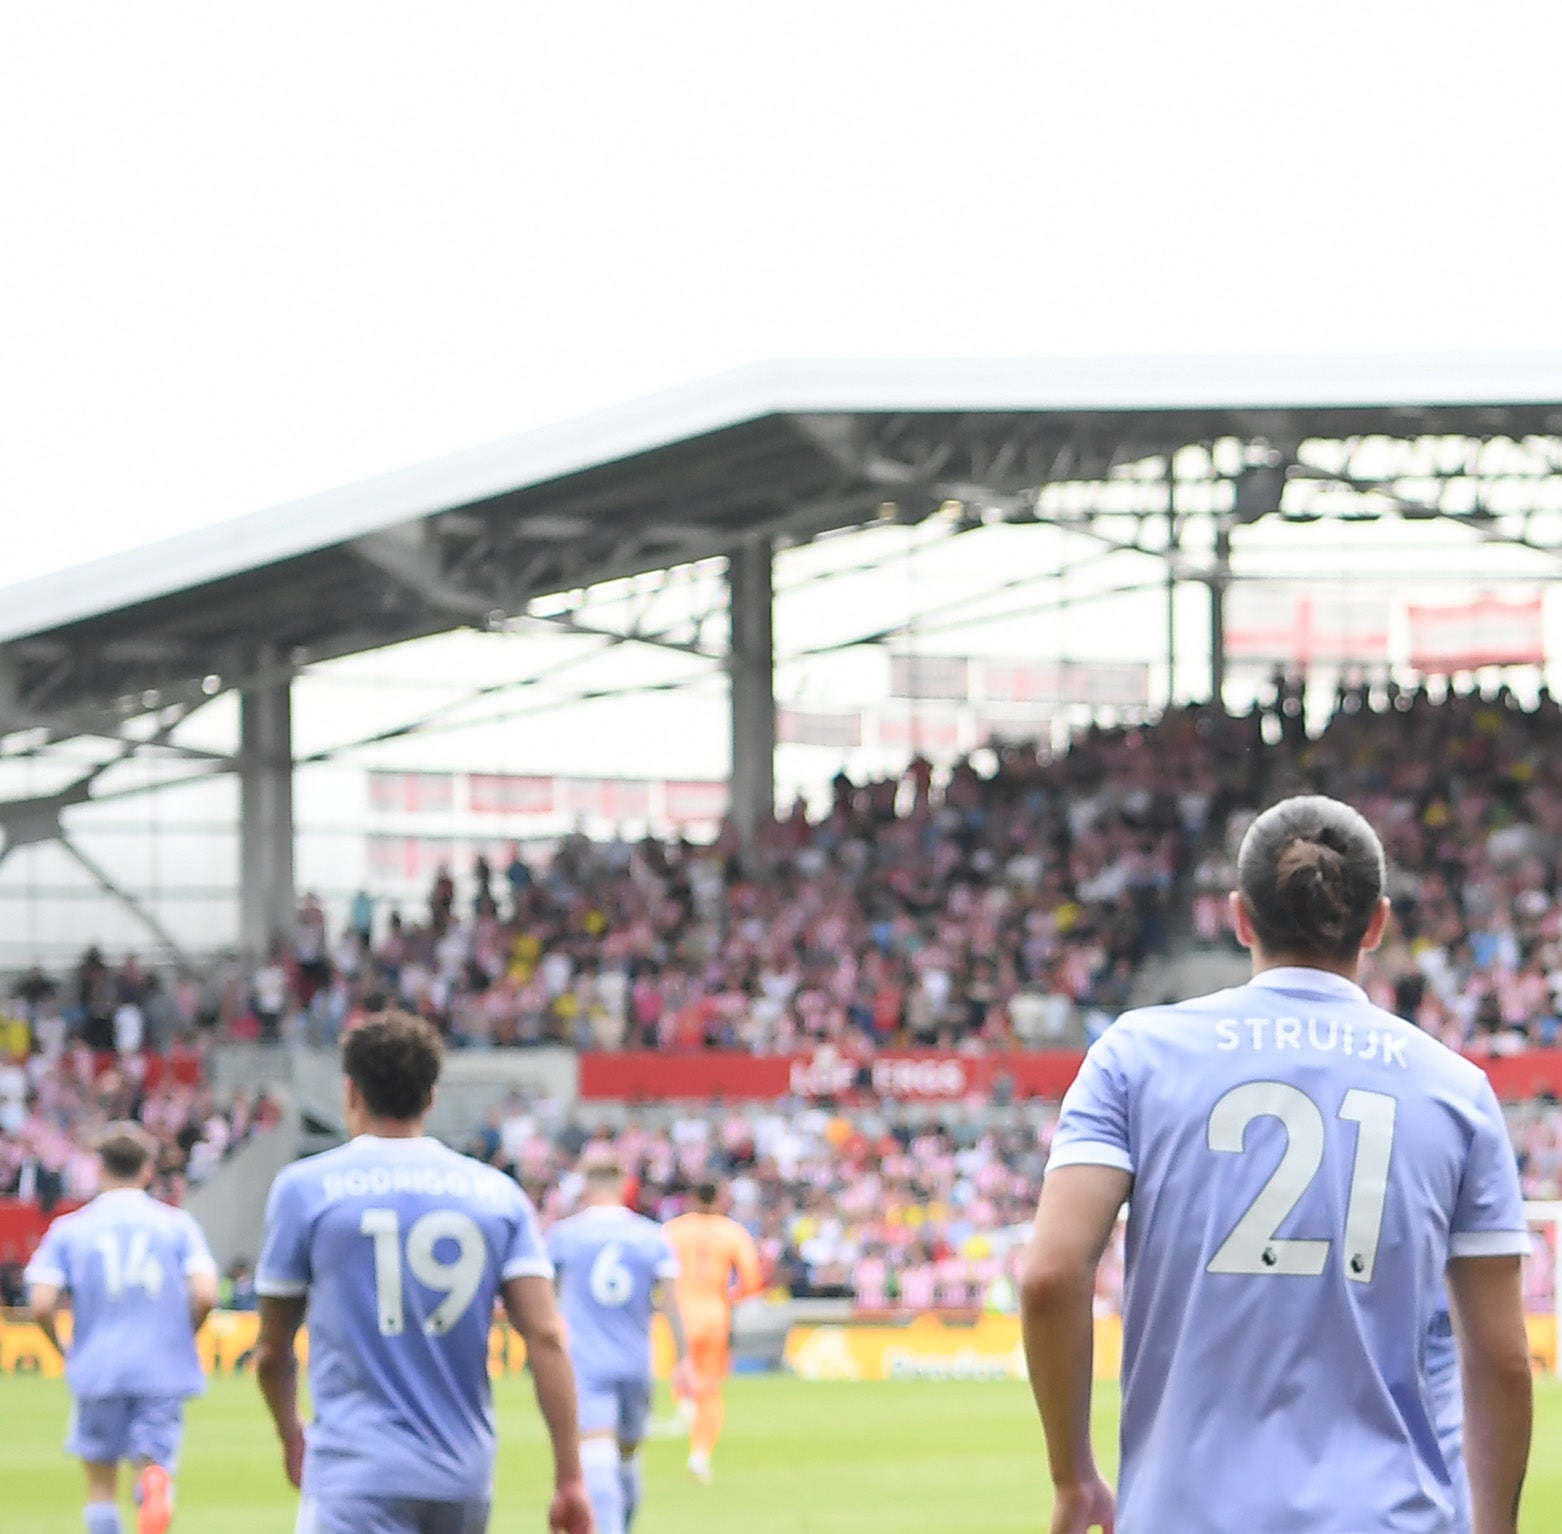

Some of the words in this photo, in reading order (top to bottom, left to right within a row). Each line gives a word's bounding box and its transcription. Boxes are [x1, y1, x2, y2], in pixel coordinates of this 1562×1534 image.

[1215, 1016, 1409, 1069] STRUIJK
[1206, 1079, 1398, 1284] 21
[96, 1232, 164, 1301] 14
[360, 1207, 488, 1337] 19
[590, 1241, 633, 1307] 6
